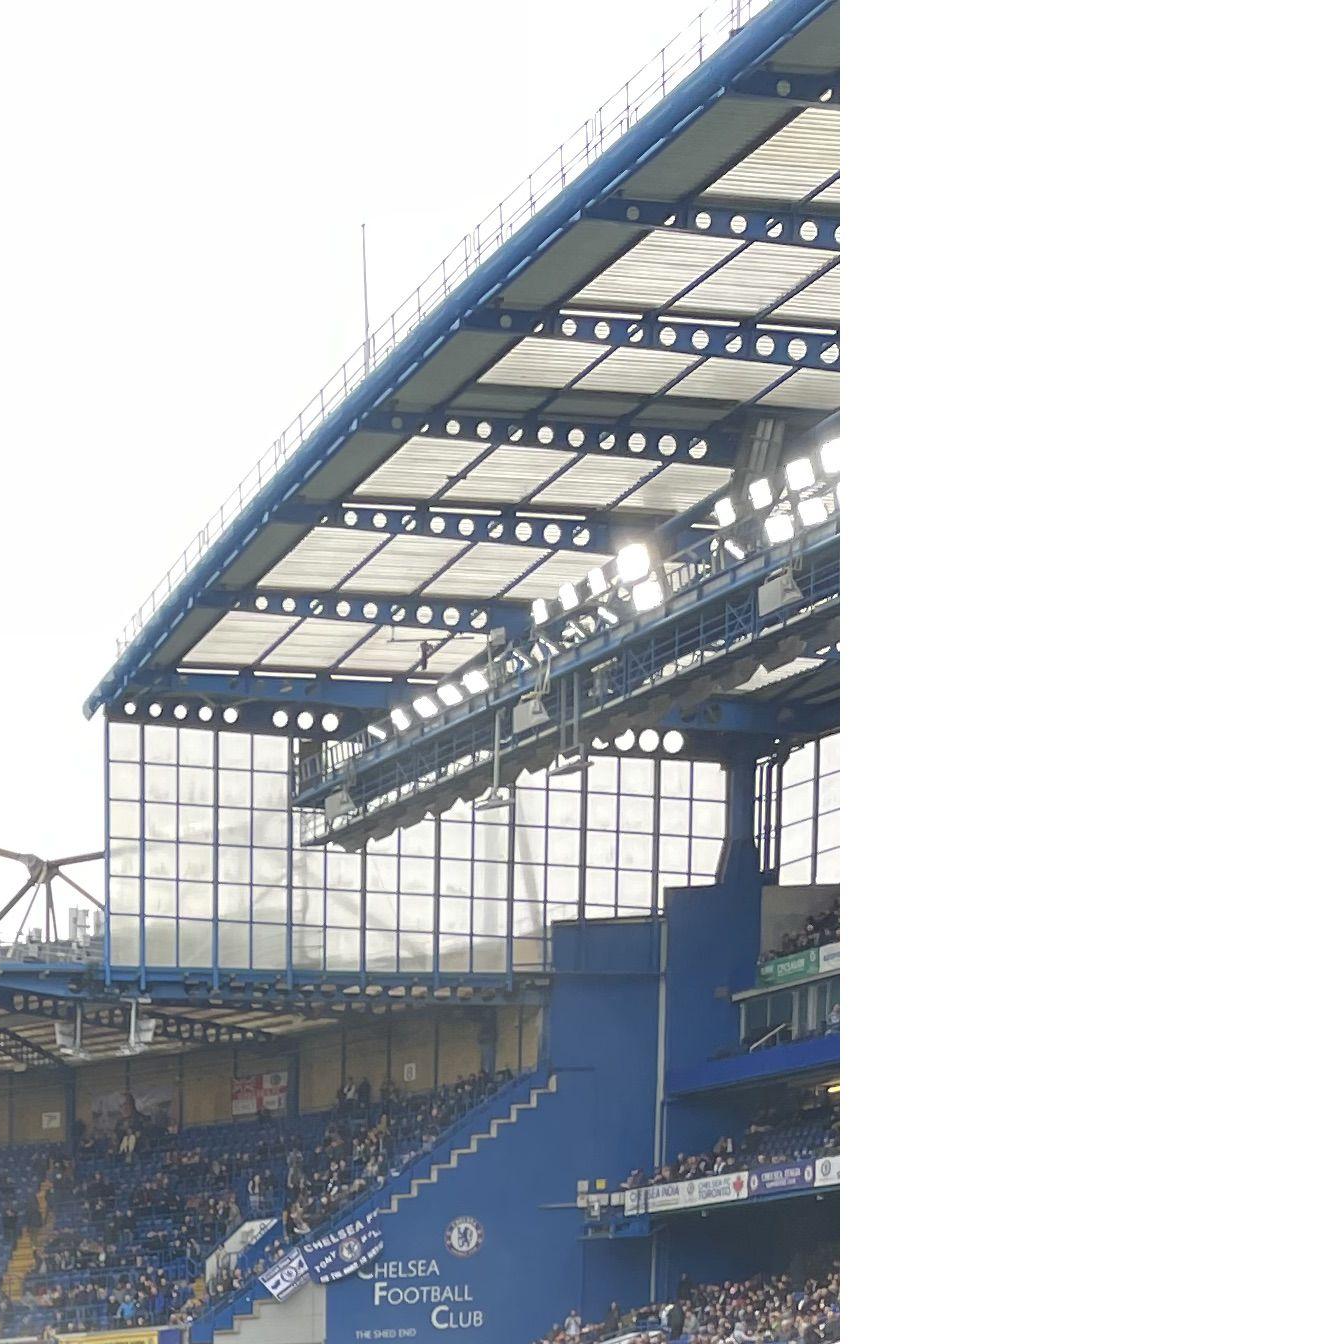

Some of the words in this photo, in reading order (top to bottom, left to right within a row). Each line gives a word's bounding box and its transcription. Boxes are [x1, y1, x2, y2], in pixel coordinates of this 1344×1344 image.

[303, 1220, 365, 1253] CHELSEA
[355, 1331, 371, 1340] THE
[374, 1329, 396, 1339] SHED
[398, 1327, 416, 1338] END
